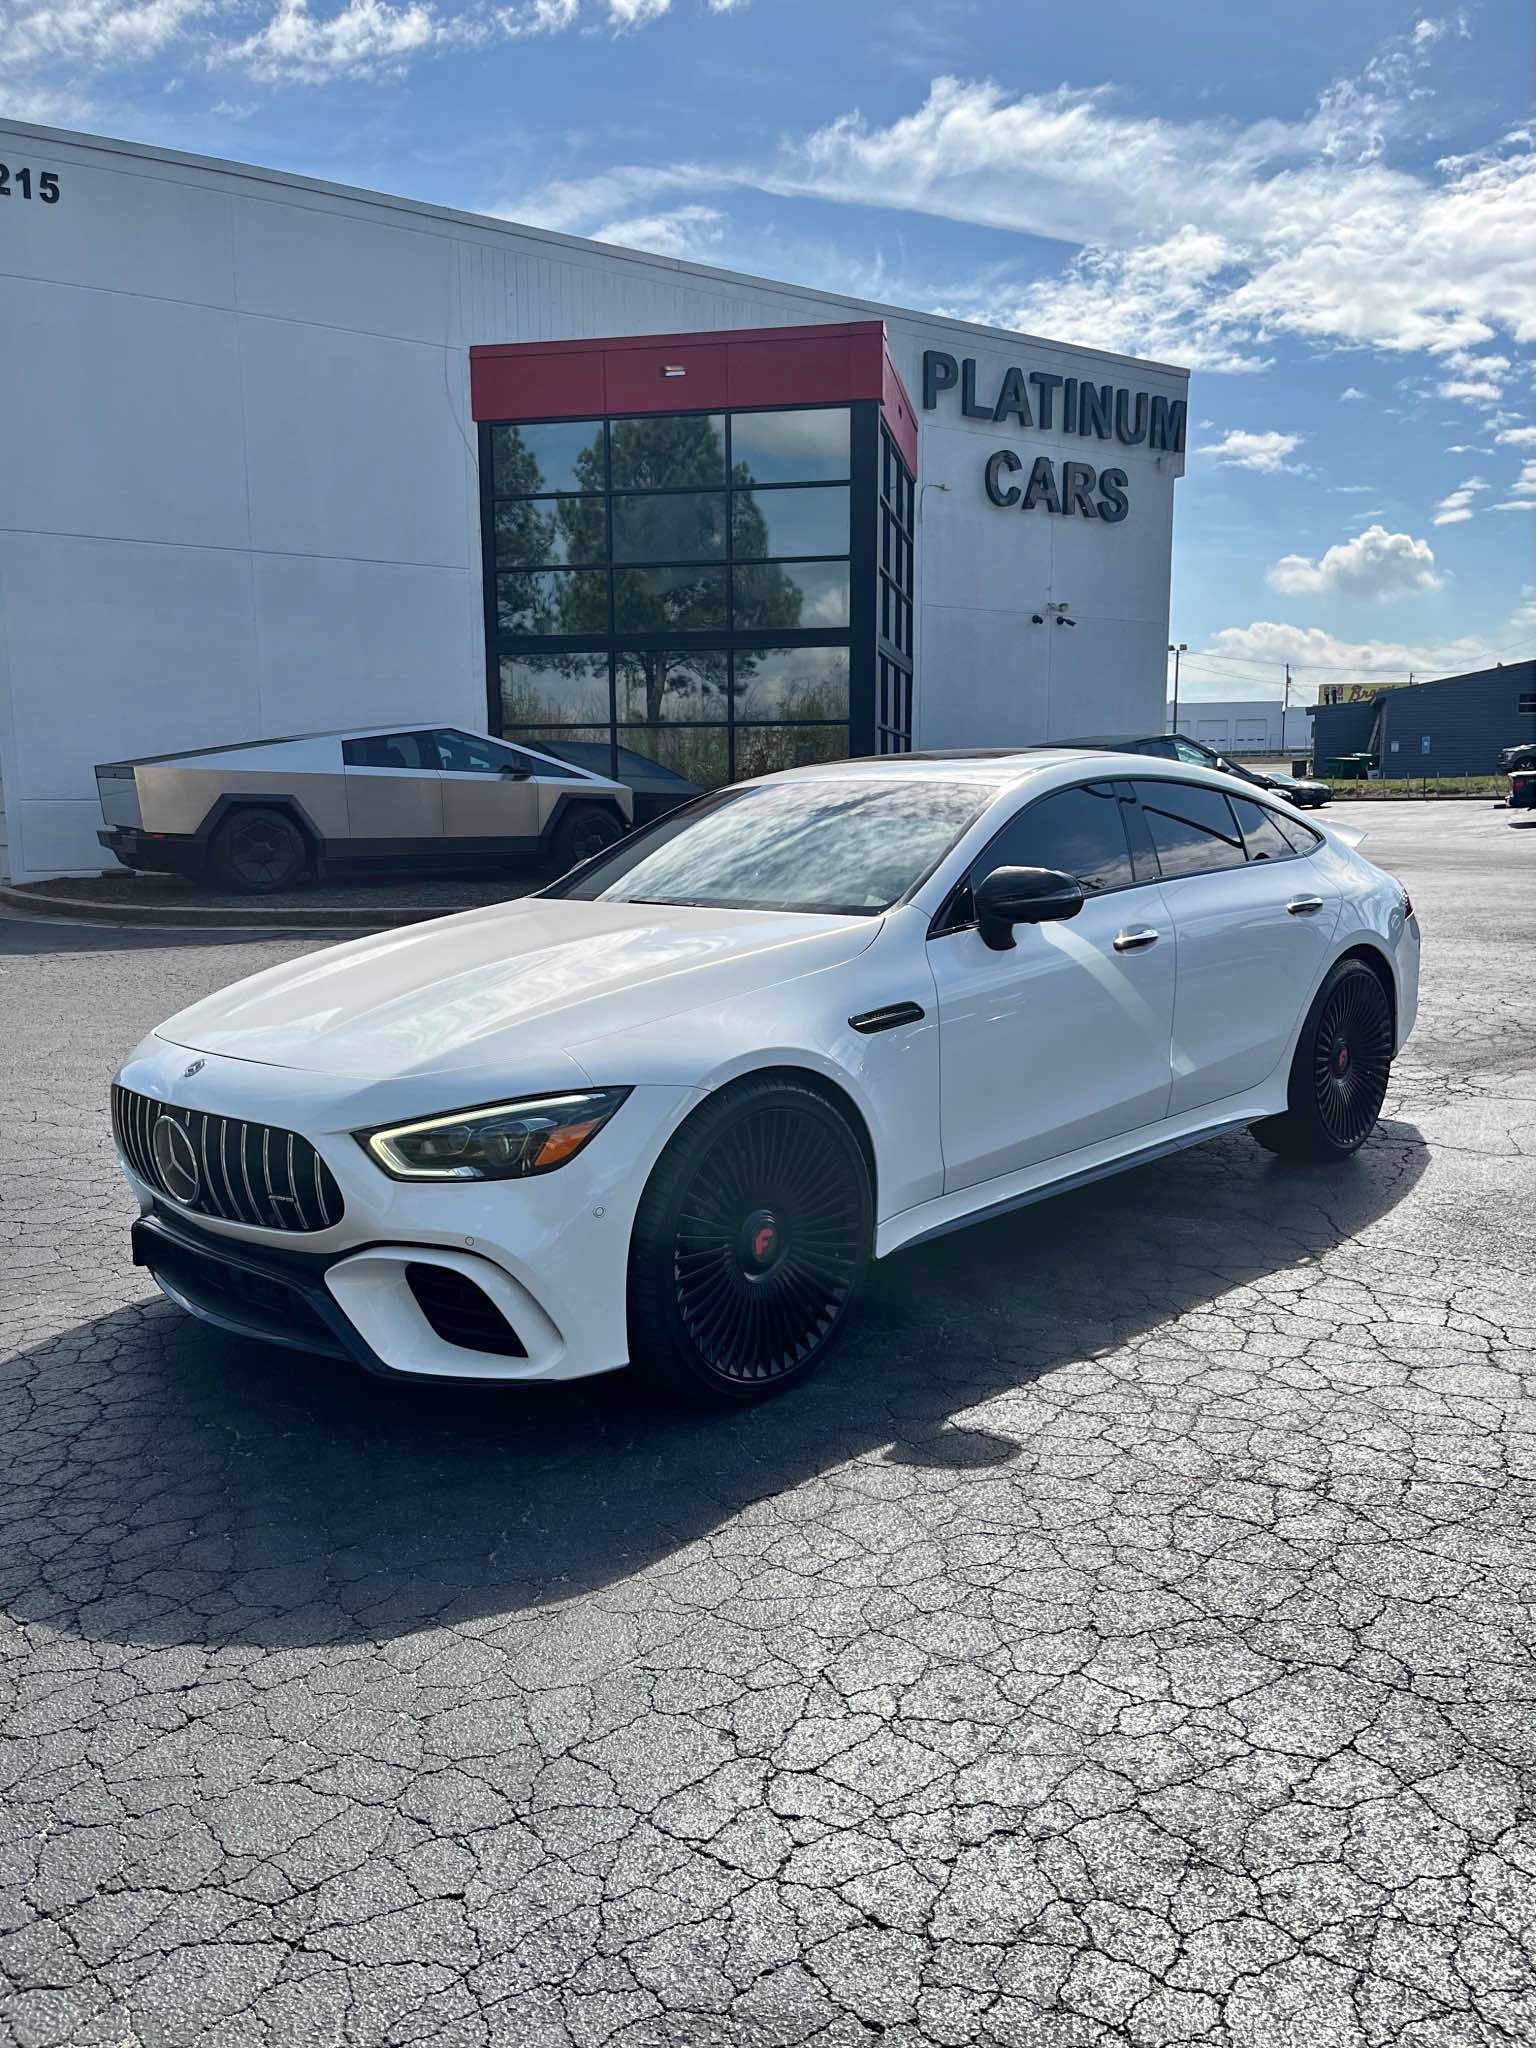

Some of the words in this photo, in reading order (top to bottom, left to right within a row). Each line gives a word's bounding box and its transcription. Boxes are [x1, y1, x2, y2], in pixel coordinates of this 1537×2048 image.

[923, 350, 1187, 452] PLATINUM
[985, 450, 1129, 522] CARS
[755, 1228, 775, 1255] F
